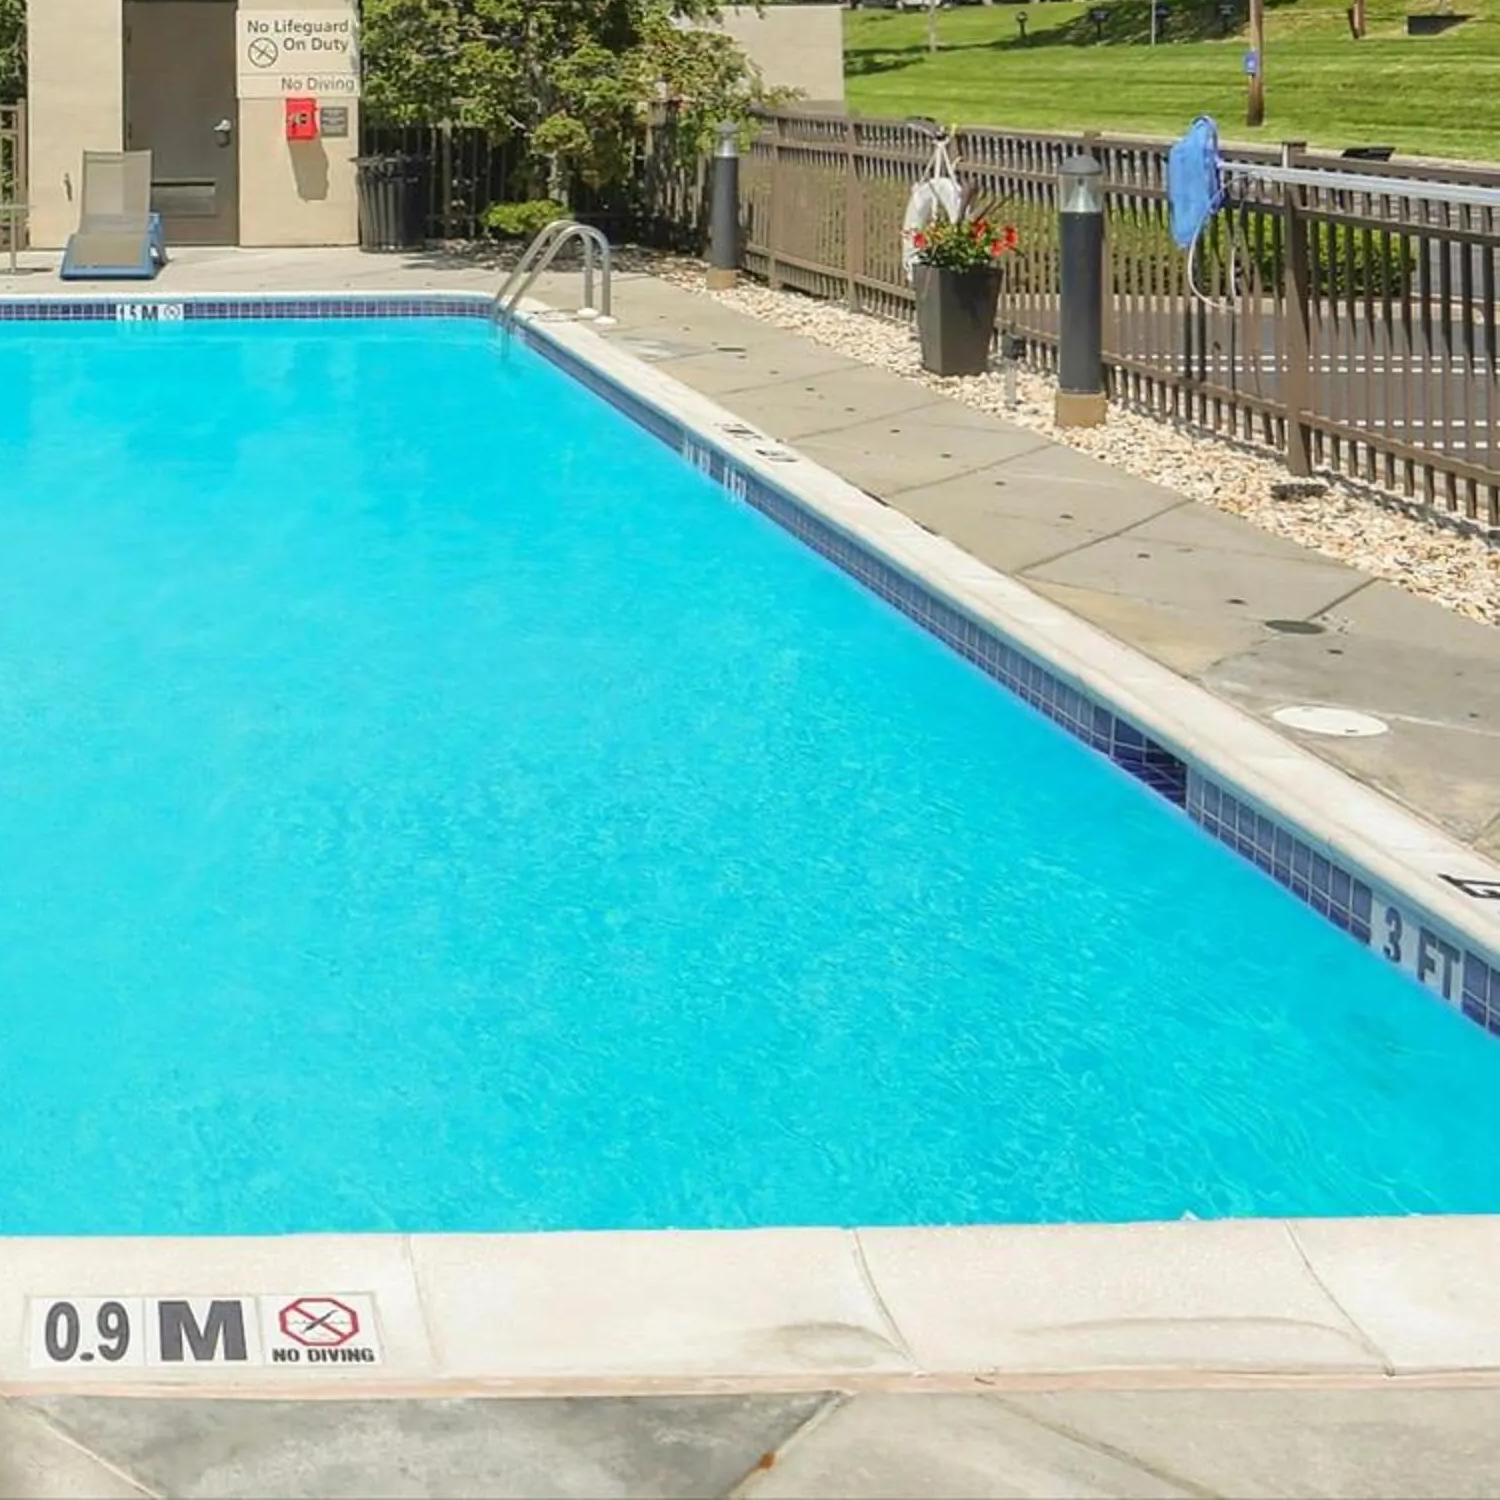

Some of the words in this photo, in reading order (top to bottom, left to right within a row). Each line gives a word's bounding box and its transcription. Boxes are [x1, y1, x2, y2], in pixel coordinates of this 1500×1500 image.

[247, 20, 268, 33] No
[274, 19, 349, 36] Lifeguard
[283, 37, 306, 51] On
[311, 37, 348, 53] Duty
[281, 78, 302, 91] No
[307, 77, 355, 93] Diving
[1382, 905, 1403, 964] 3
[1417, 926, 1462, 1001] FT
[44, 1300, 131, 1362] 0.9
[156, 1299, 249, 1361] M
[271, 1348, 301, 1363] NO
[306, 1348, 376, 1363] DIVING
